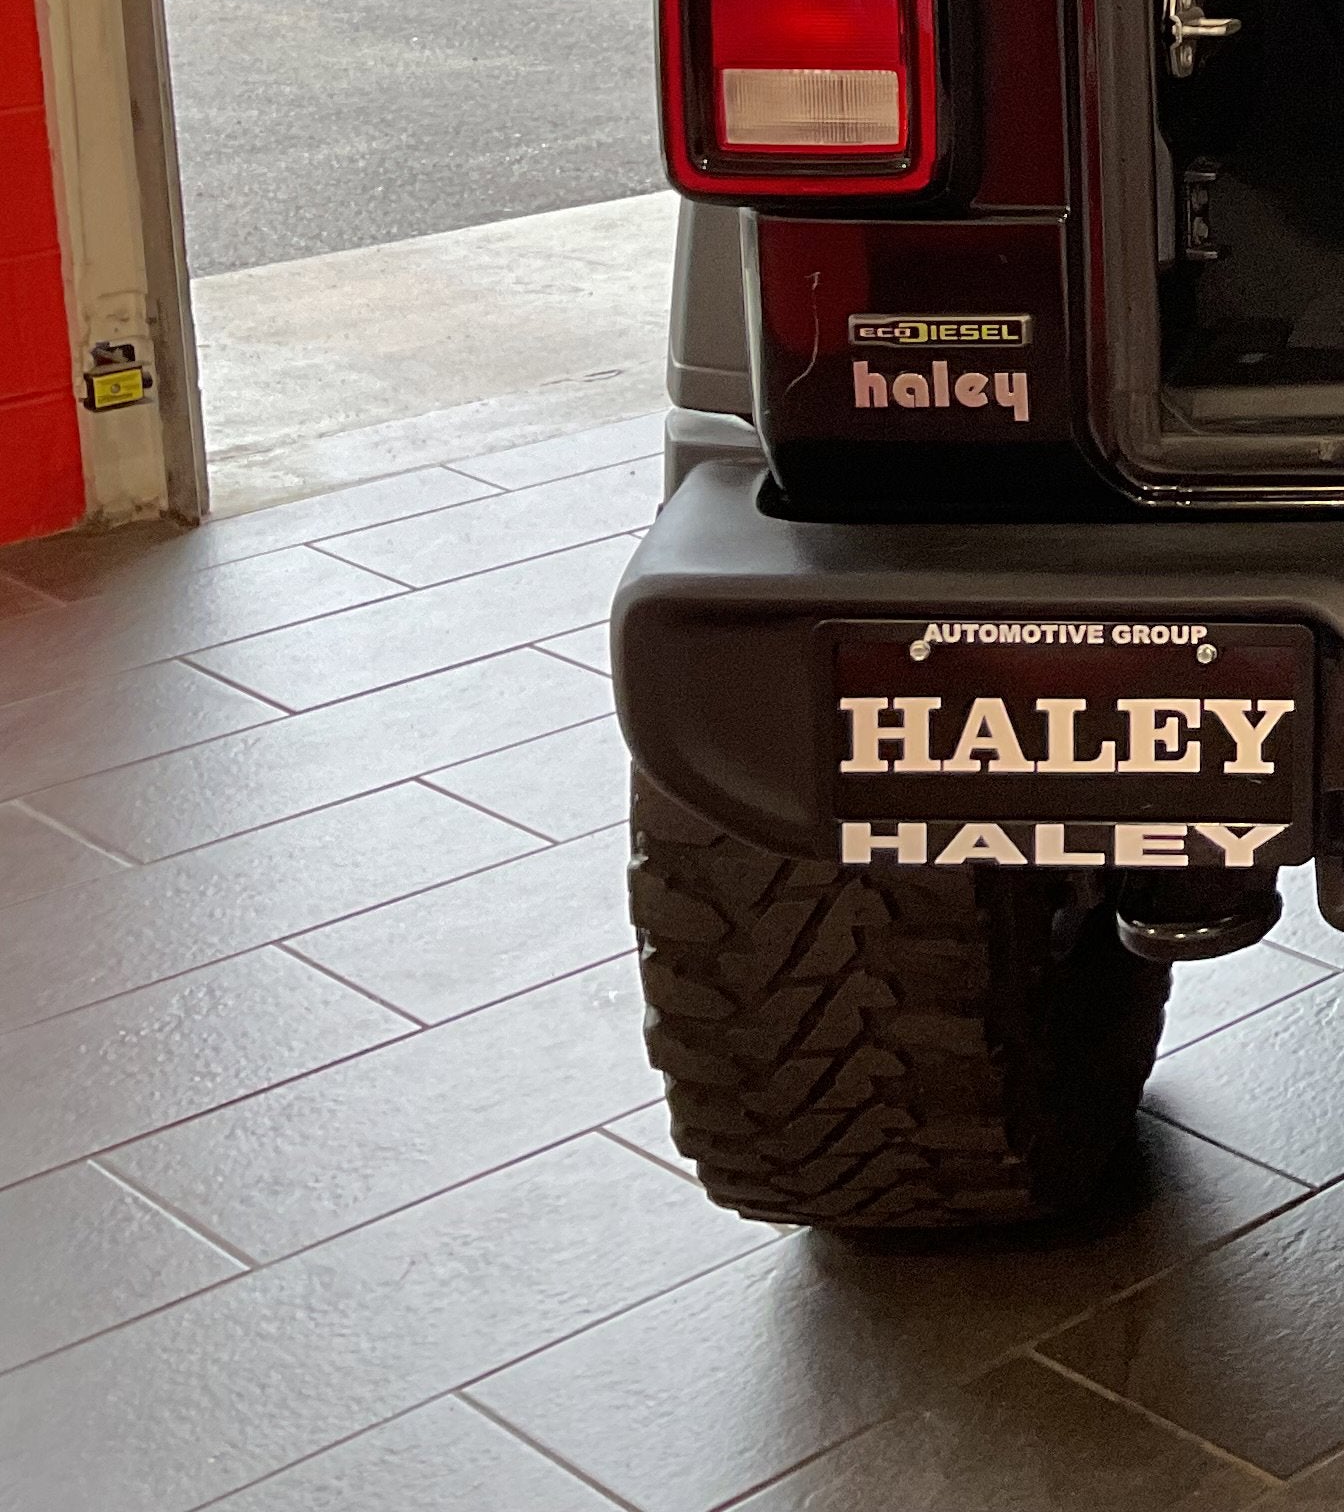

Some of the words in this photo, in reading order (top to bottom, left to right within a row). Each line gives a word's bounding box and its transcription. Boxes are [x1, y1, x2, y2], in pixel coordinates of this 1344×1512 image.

[853, 360, 1029, 423] haley
[923, 623, 1105, 645] AUTOMOTIVE
[1111, 625, 1208, 645] GROUP
[839, 696, 1295, 774] HALEY
[841, 822, 1291, 867] HALEY
